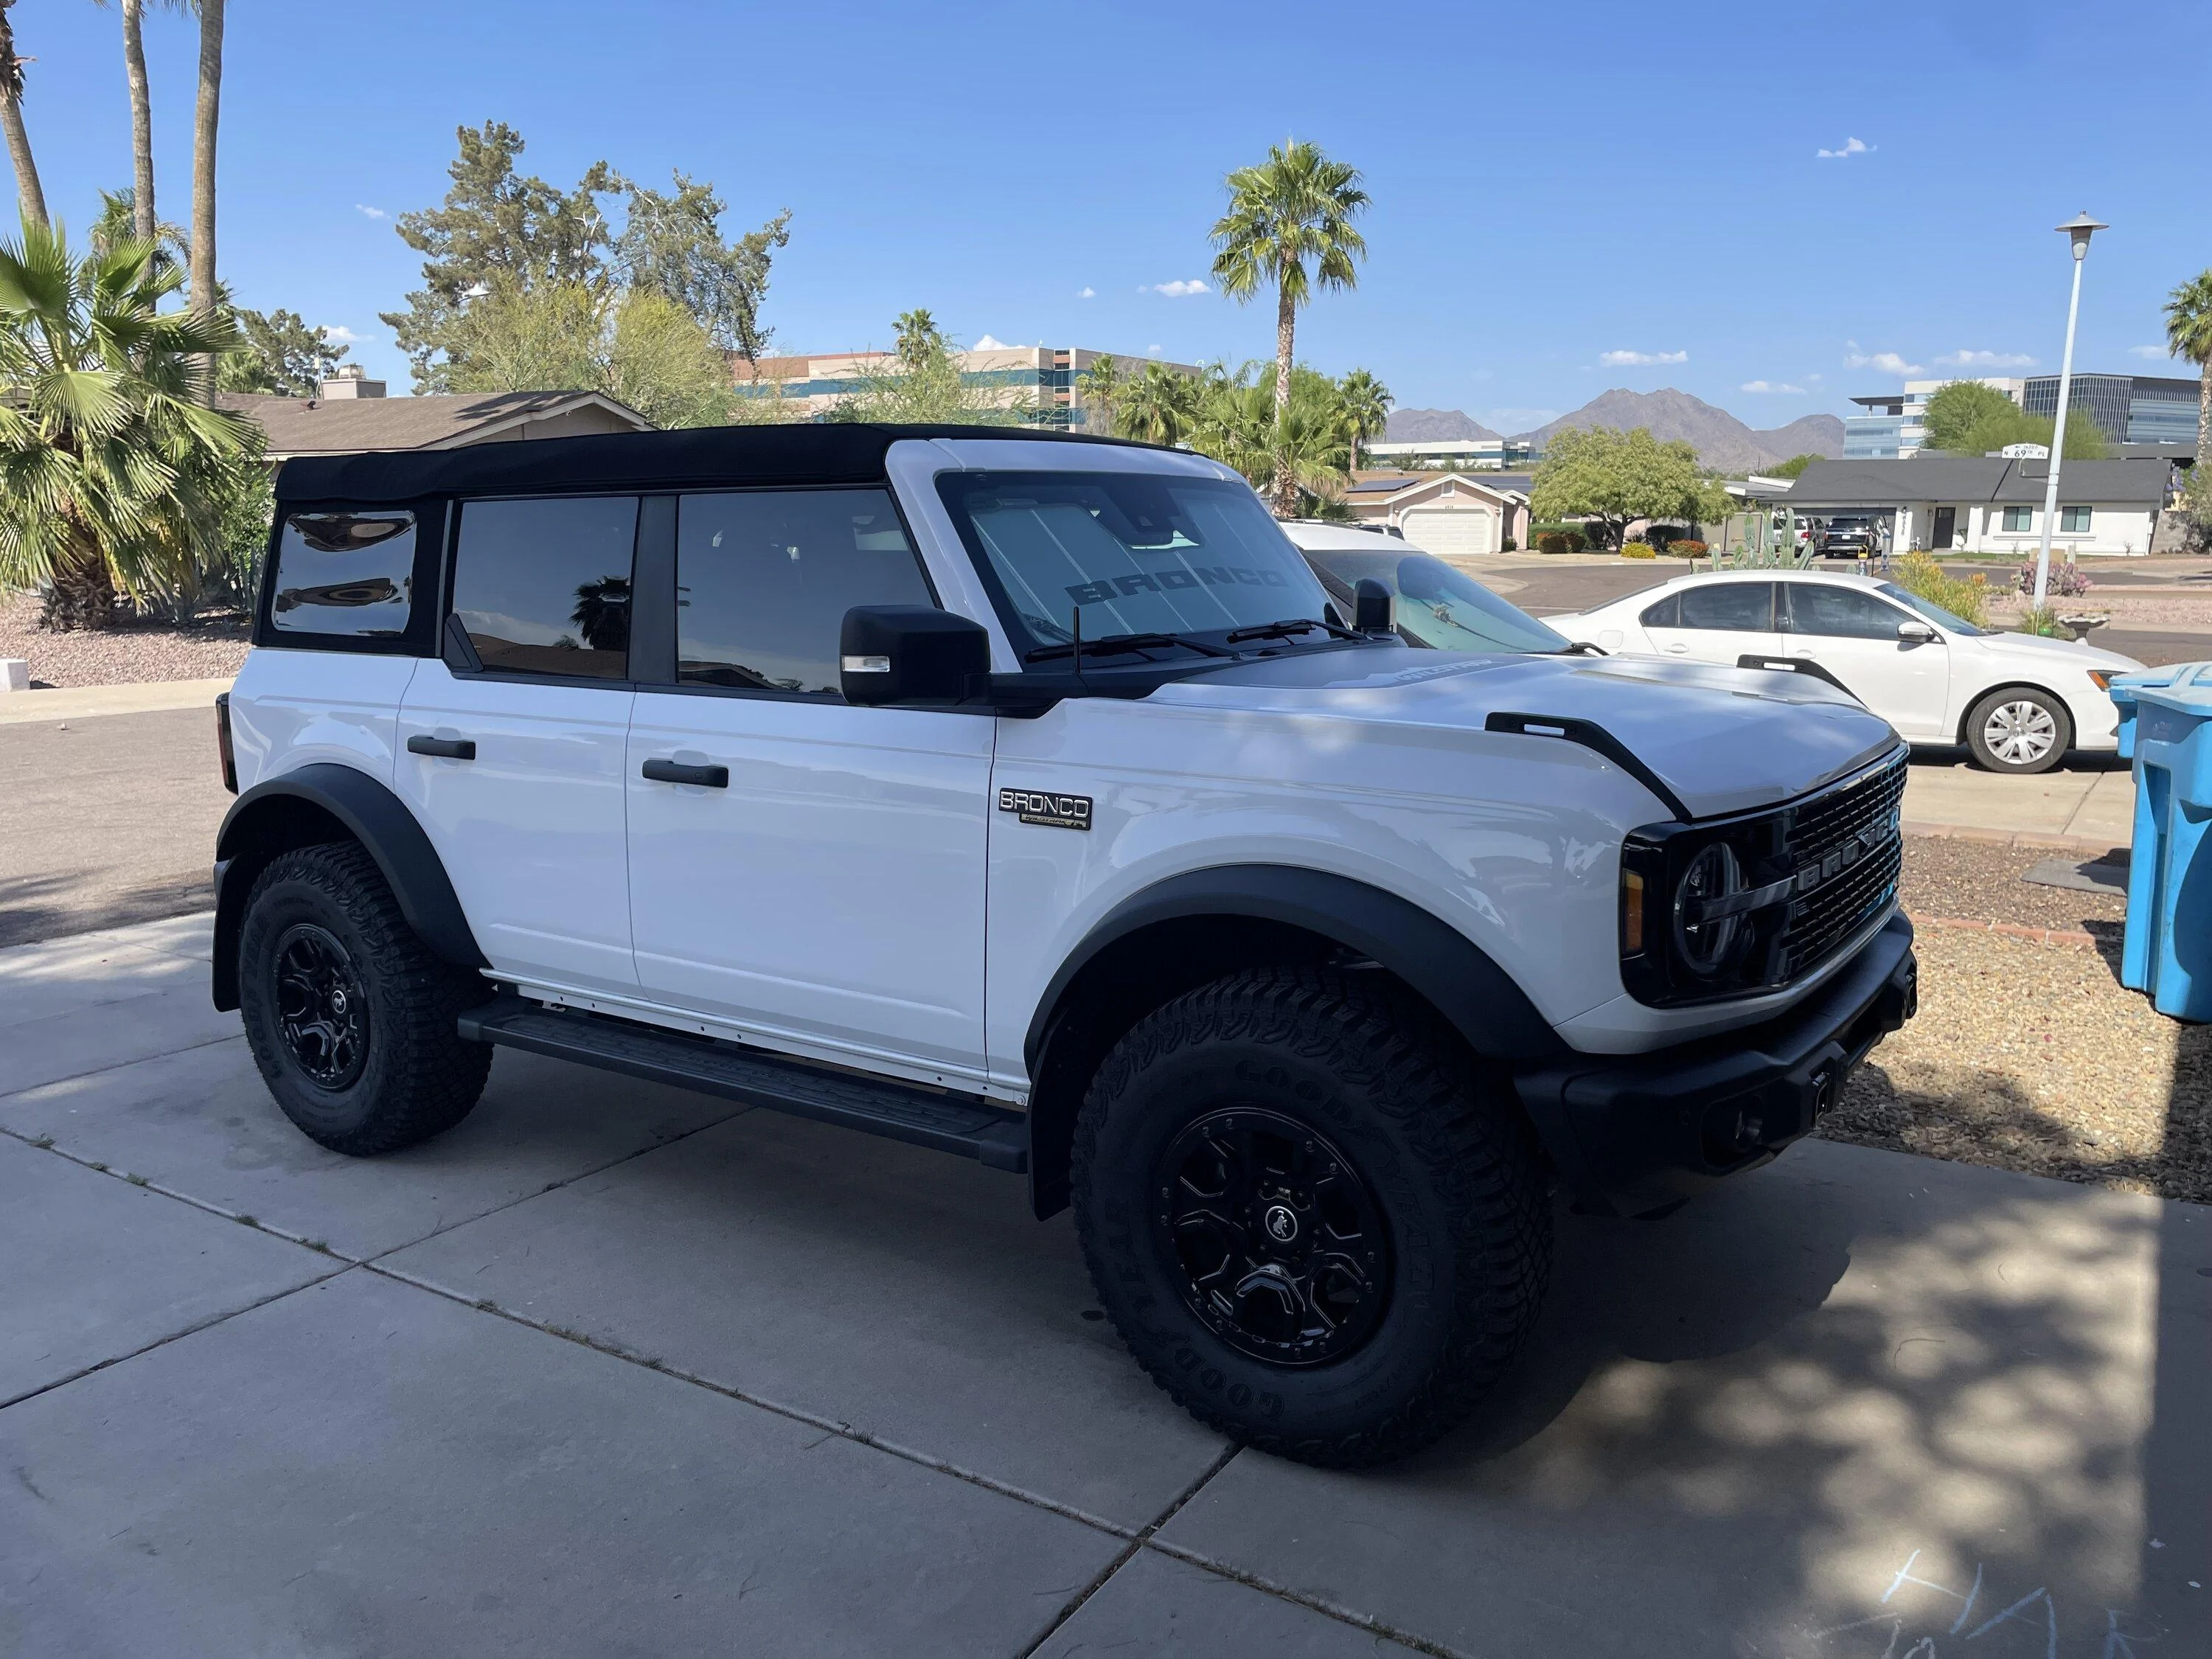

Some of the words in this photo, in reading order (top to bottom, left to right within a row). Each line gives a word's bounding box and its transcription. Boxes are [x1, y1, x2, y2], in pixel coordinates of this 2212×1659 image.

[1064, 566, 1290, 606] BRONCO
[1000, 790, 1089, 818] BRONCO
[1798, 805, 1900, 891] BRONCO
